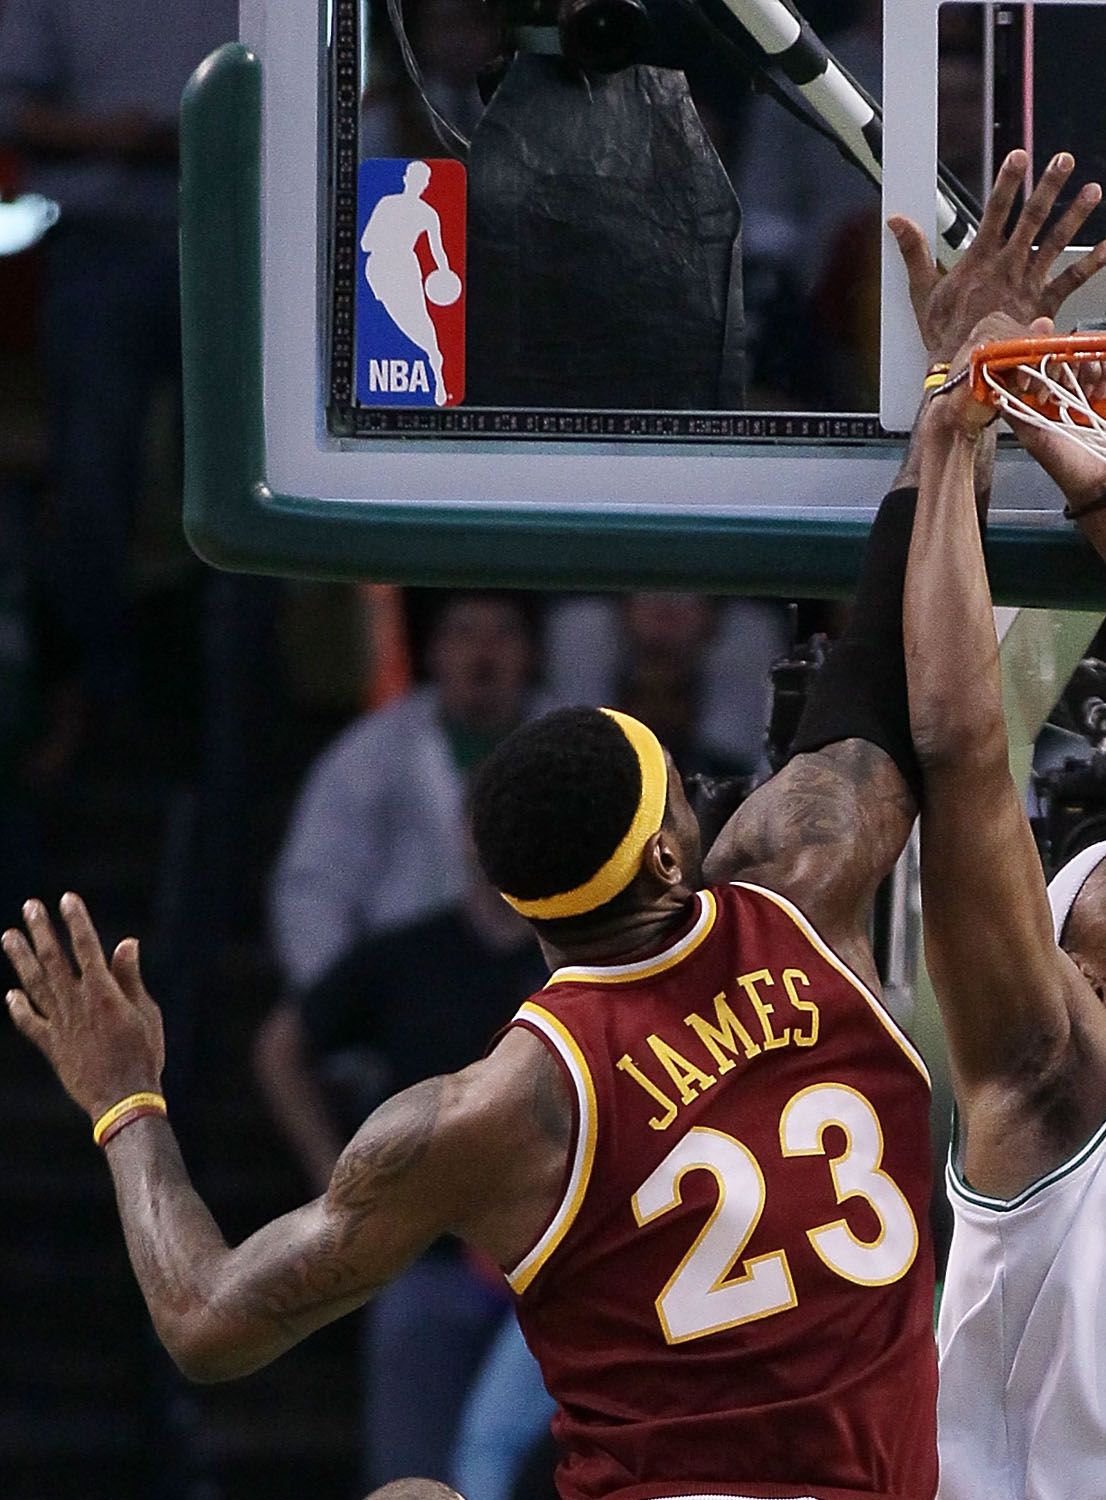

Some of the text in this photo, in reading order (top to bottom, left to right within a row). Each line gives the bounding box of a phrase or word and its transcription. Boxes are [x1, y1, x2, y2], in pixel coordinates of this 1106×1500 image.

[369, 359, 430, 392] NBA
[616, 968, 820, 1131] JAMES
[631, 1082, 919, 1345] 23
